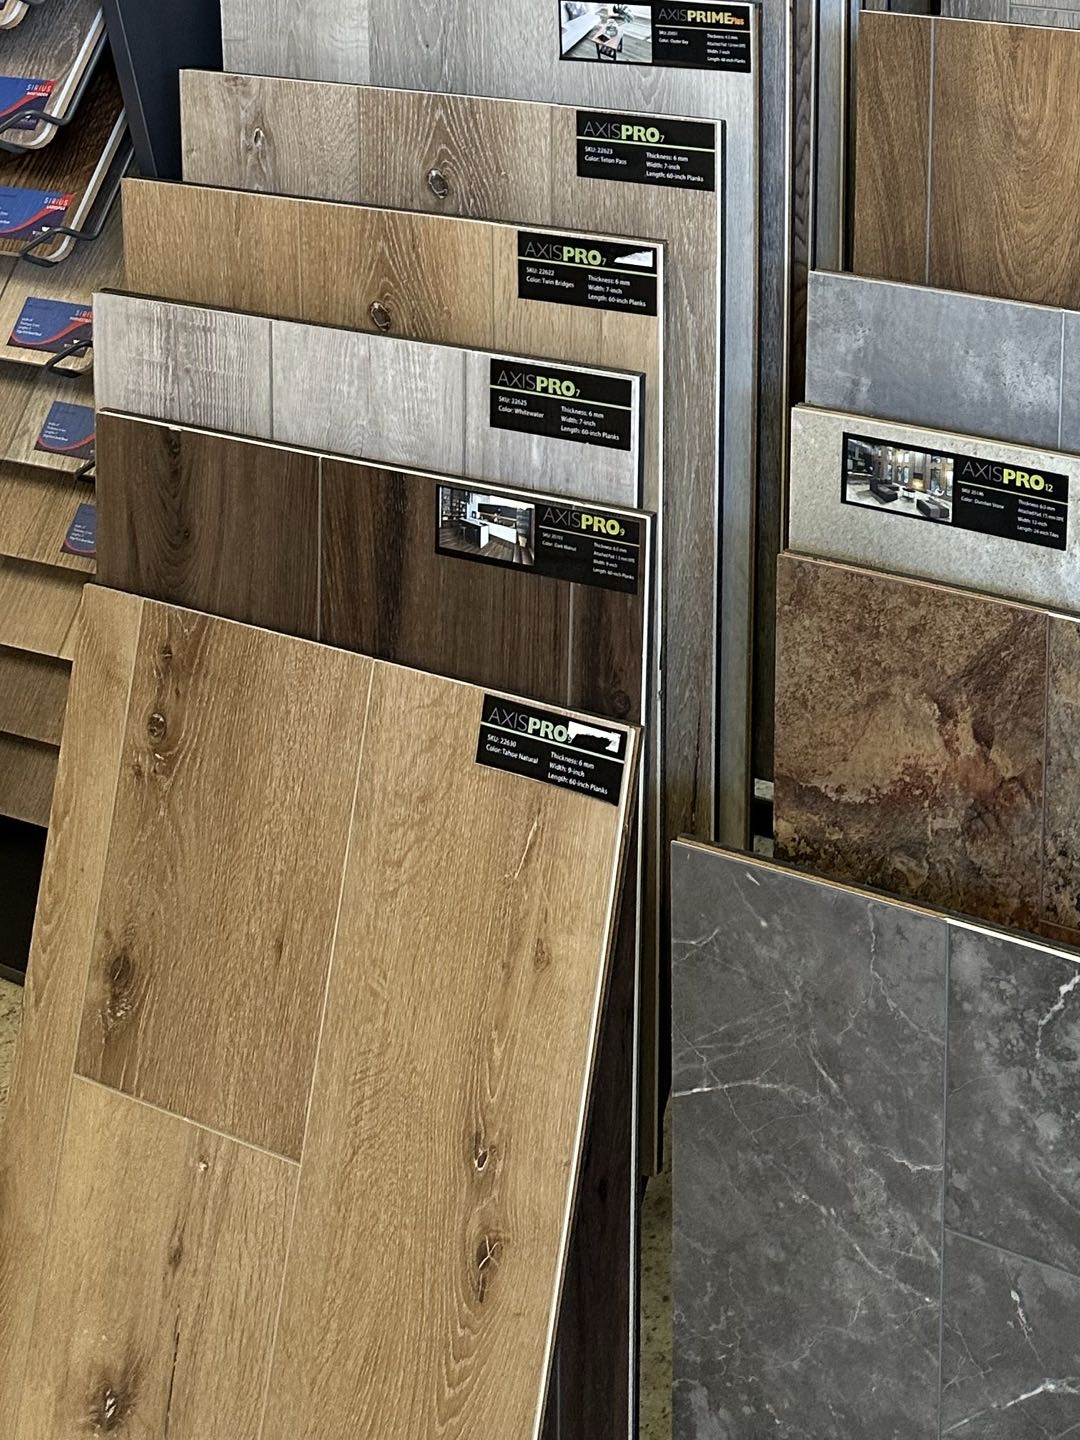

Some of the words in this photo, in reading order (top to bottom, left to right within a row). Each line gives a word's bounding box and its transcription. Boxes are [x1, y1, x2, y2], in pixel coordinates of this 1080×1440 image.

[555, 280, 574, 288] Bridges
[515, 408, 544, 418] Whitewater
[503, 748, 518, 758] Tahoe
[519, 752, 539, 763] Natural
